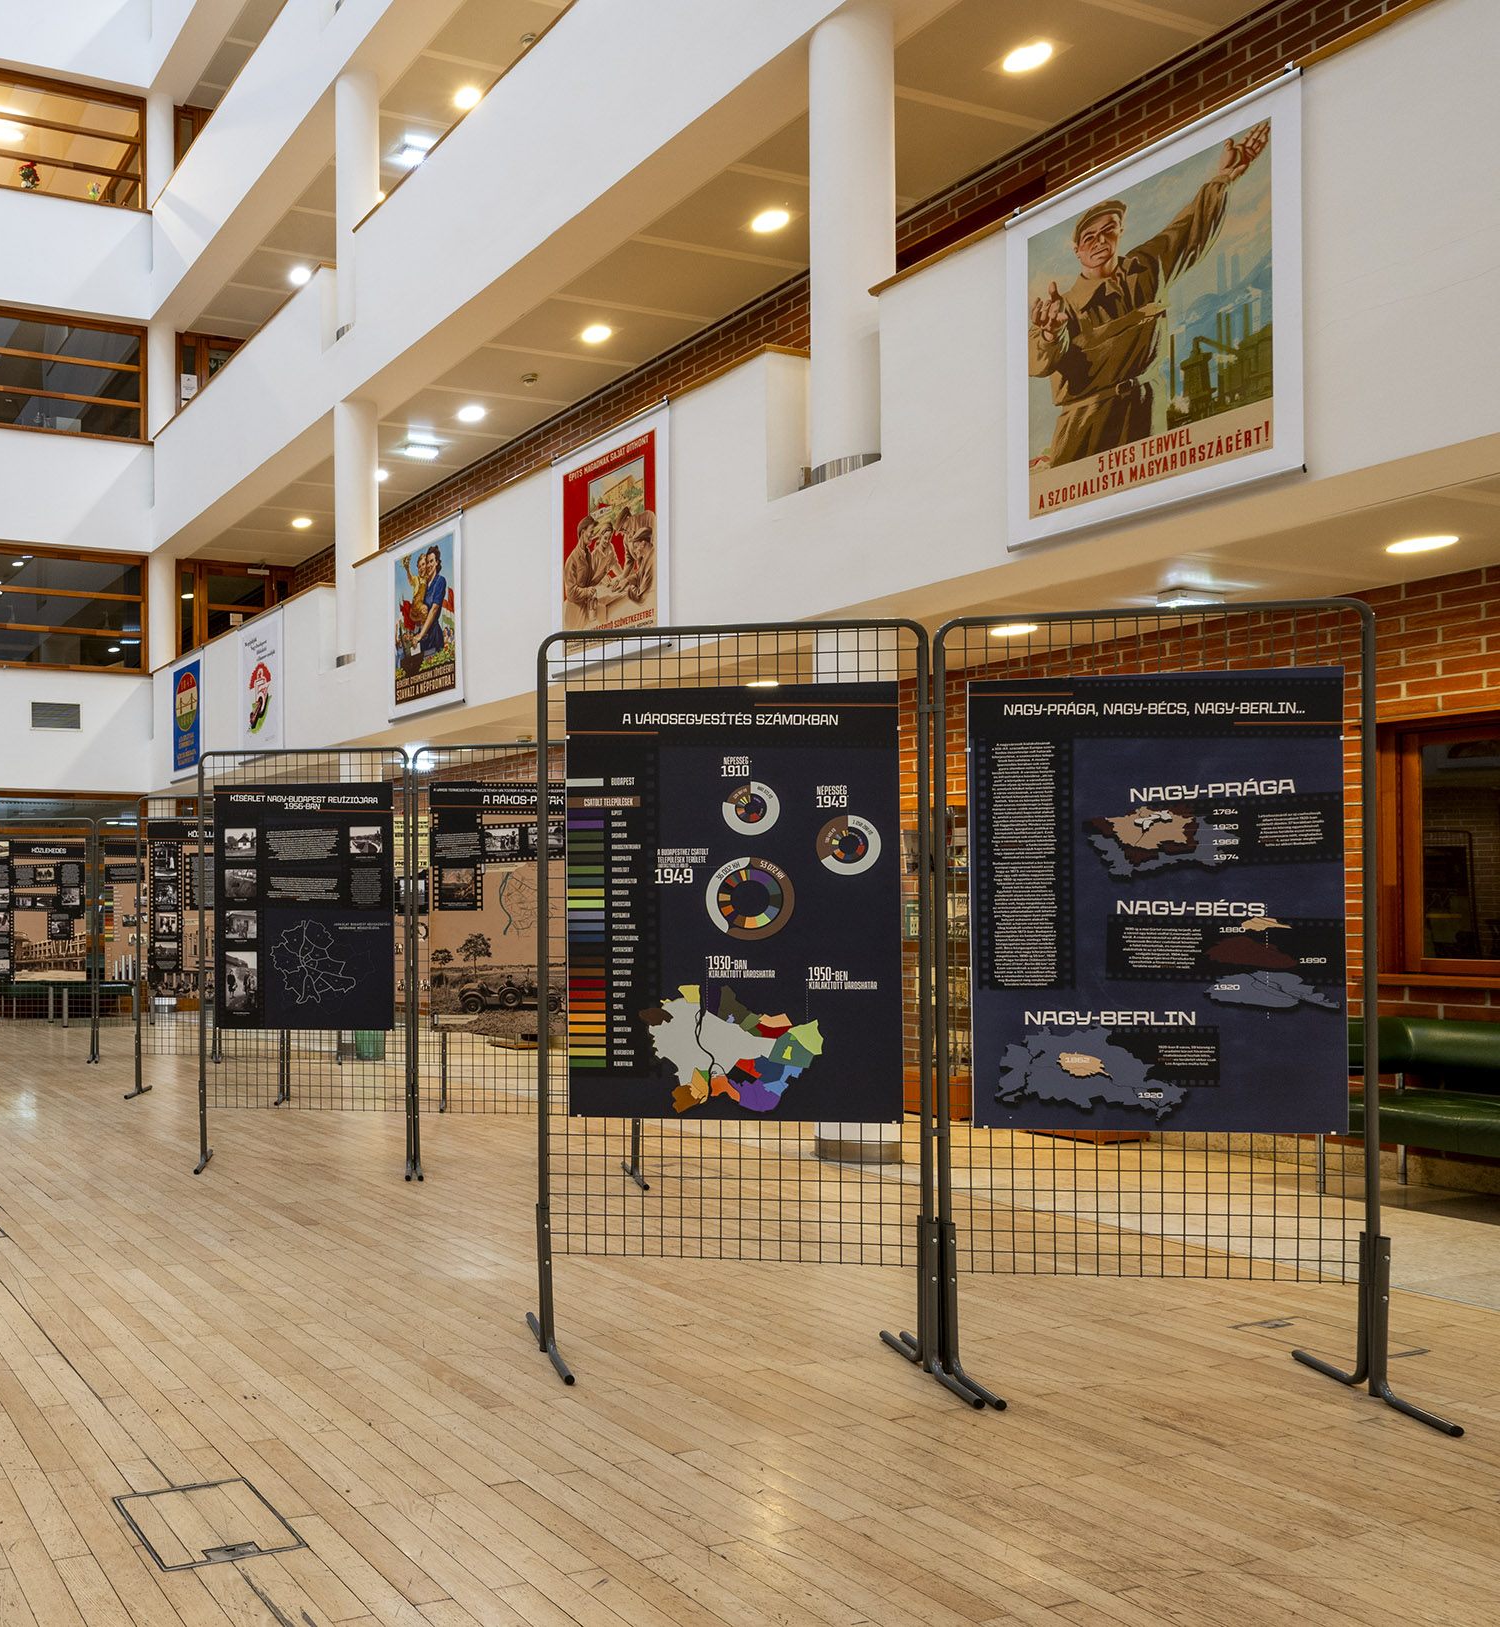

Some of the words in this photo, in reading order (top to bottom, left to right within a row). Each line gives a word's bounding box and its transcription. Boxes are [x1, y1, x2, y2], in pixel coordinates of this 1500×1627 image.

[1098, 456, 1104, 472] 5
[1108, 450, 1136, 470] ÉVES
[1142, 428, 1192, 459] TERVVEL
[1038, 494, 1045, 510] A
[1048, 472, 1124, 507] SZOCIALISTA
[1129, 420, 1270, 483] MAGYARORSZÁGÉRT!
[1003, 702, 1099, 718] NAGY-PRÁGA,
[1103, 701, 1190, 716] NAGY-BÉCS,
[622, 715, 631, 725] A
[635, 712, 752, 725] VÁROSEGYESÍTÉS
[756, 712, 839, 726] SZÁMOKBAN
[723, 756, 749, 765] NÉPESSÉG
[721, 765, 750, 777] 1910
[611, 777, 635, 786] BUDAPEST
[816, 785, 847, 796] NÉPESSÉG
[1130, 777, 1296, 803] NAGY-PRÁGA
[267, 795, 326, 803] NAGY-BUDAPEST
[483, 795, 490, 804] A
[493, 794, 564, 805] RÁKOS-PAK
[816, 796, 847, 808] 1949
[654, 868, 694, 884] 1949
[1117, 899, 1266, 917] NAGY-BÉCS
[708, 956, 747, 970] 1930-BAN
[808, 966, 848, 981] 1950-BEN
[1025, 1011, 1196, 1026] NAGY-BERLIN
